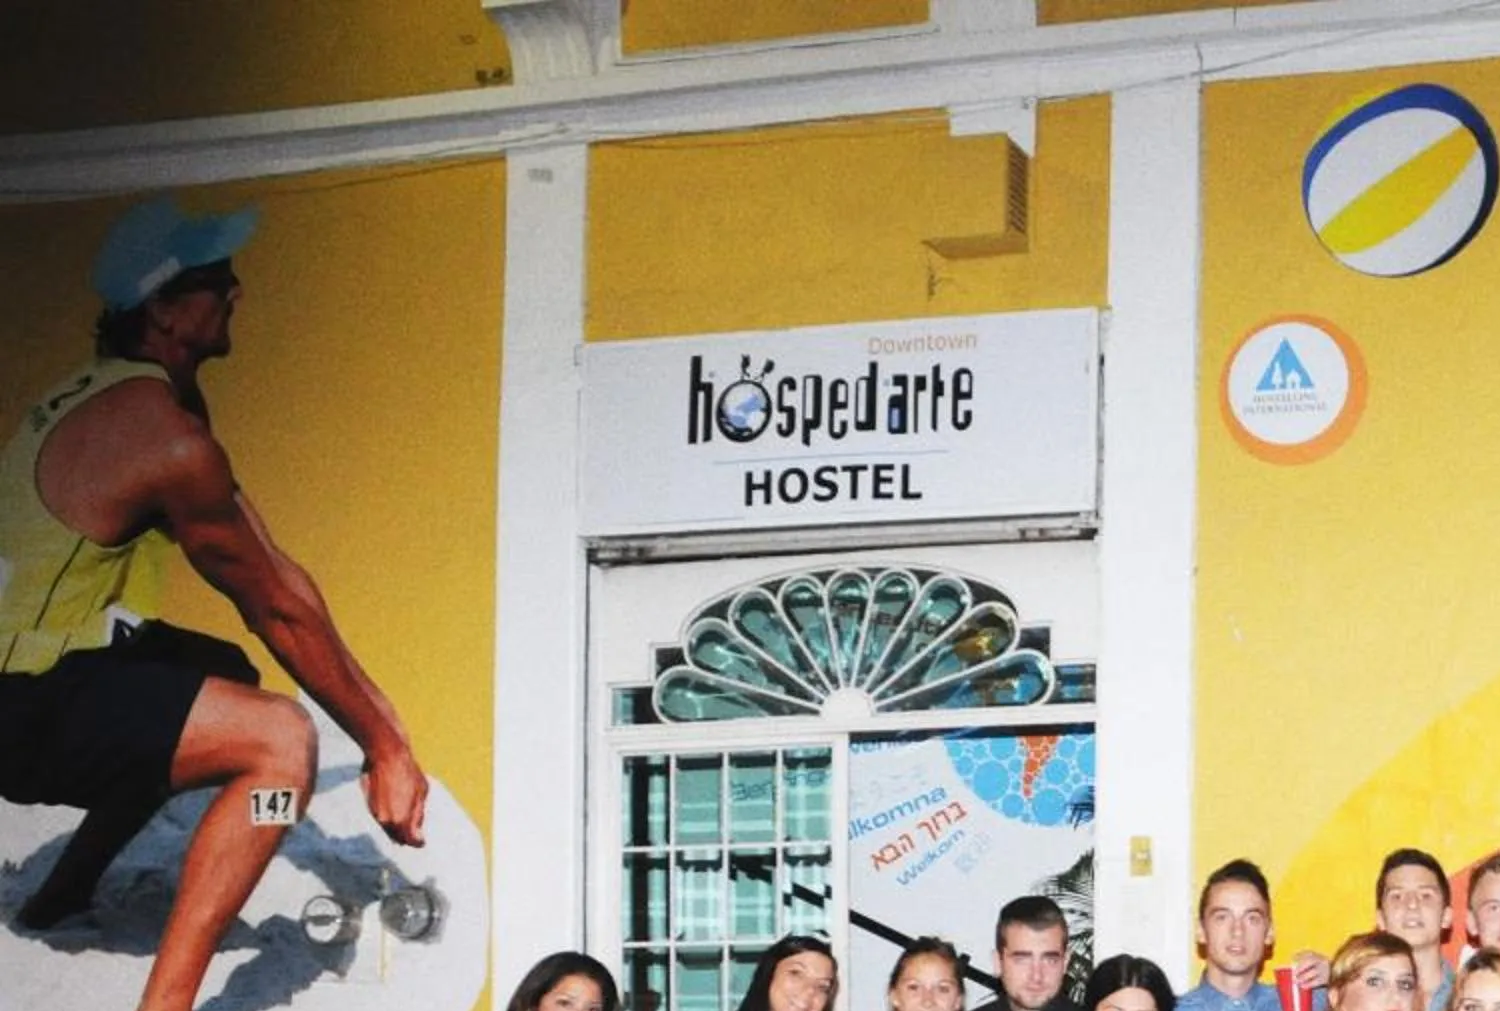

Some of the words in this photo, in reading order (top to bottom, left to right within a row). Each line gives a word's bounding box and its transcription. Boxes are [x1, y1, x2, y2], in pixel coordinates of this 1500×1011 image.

[868, 331, 978, 355] Downtown
[687, 353, 974, 446] hospedarte
[744, 464, 923, 506] HOSTEL
[252, 791, 292, 815] 147
[870, 833, 915, 872] הבא
